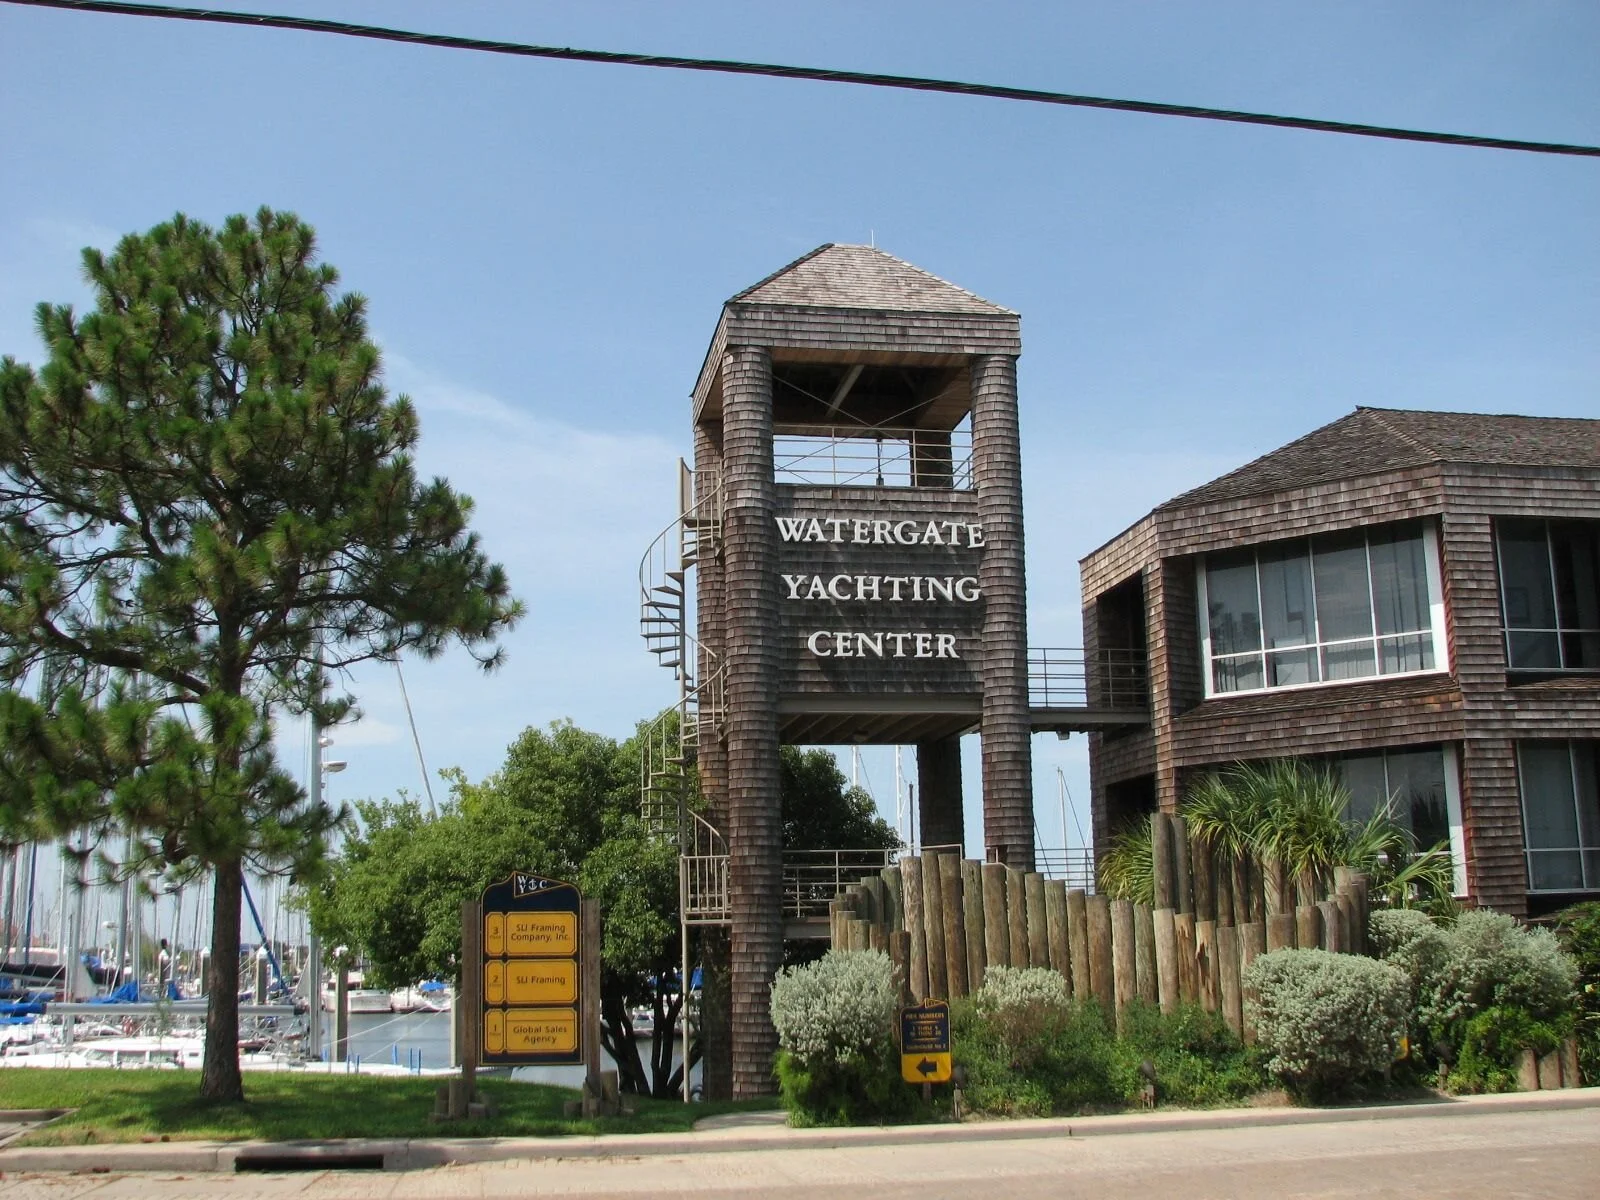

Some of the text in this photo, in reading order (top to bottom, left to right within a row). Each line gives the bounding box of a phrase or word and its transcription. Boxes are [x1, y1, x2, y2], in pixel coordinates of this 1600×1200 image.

[775, 517, 985, 549] WATERGATE
[781, 574, 982, 602] YACHTING
[807, 630, 960, 658] CENTER
[493, 927, 499, 935] 3
[531, 923, 566, 933] Framing
[493, 975, 499, 983] 2
[531, 975, 566, 985] Framing
[513, 1025, 567, 1034] Global Sales
[523, 1034, 557, 1044] Agency
